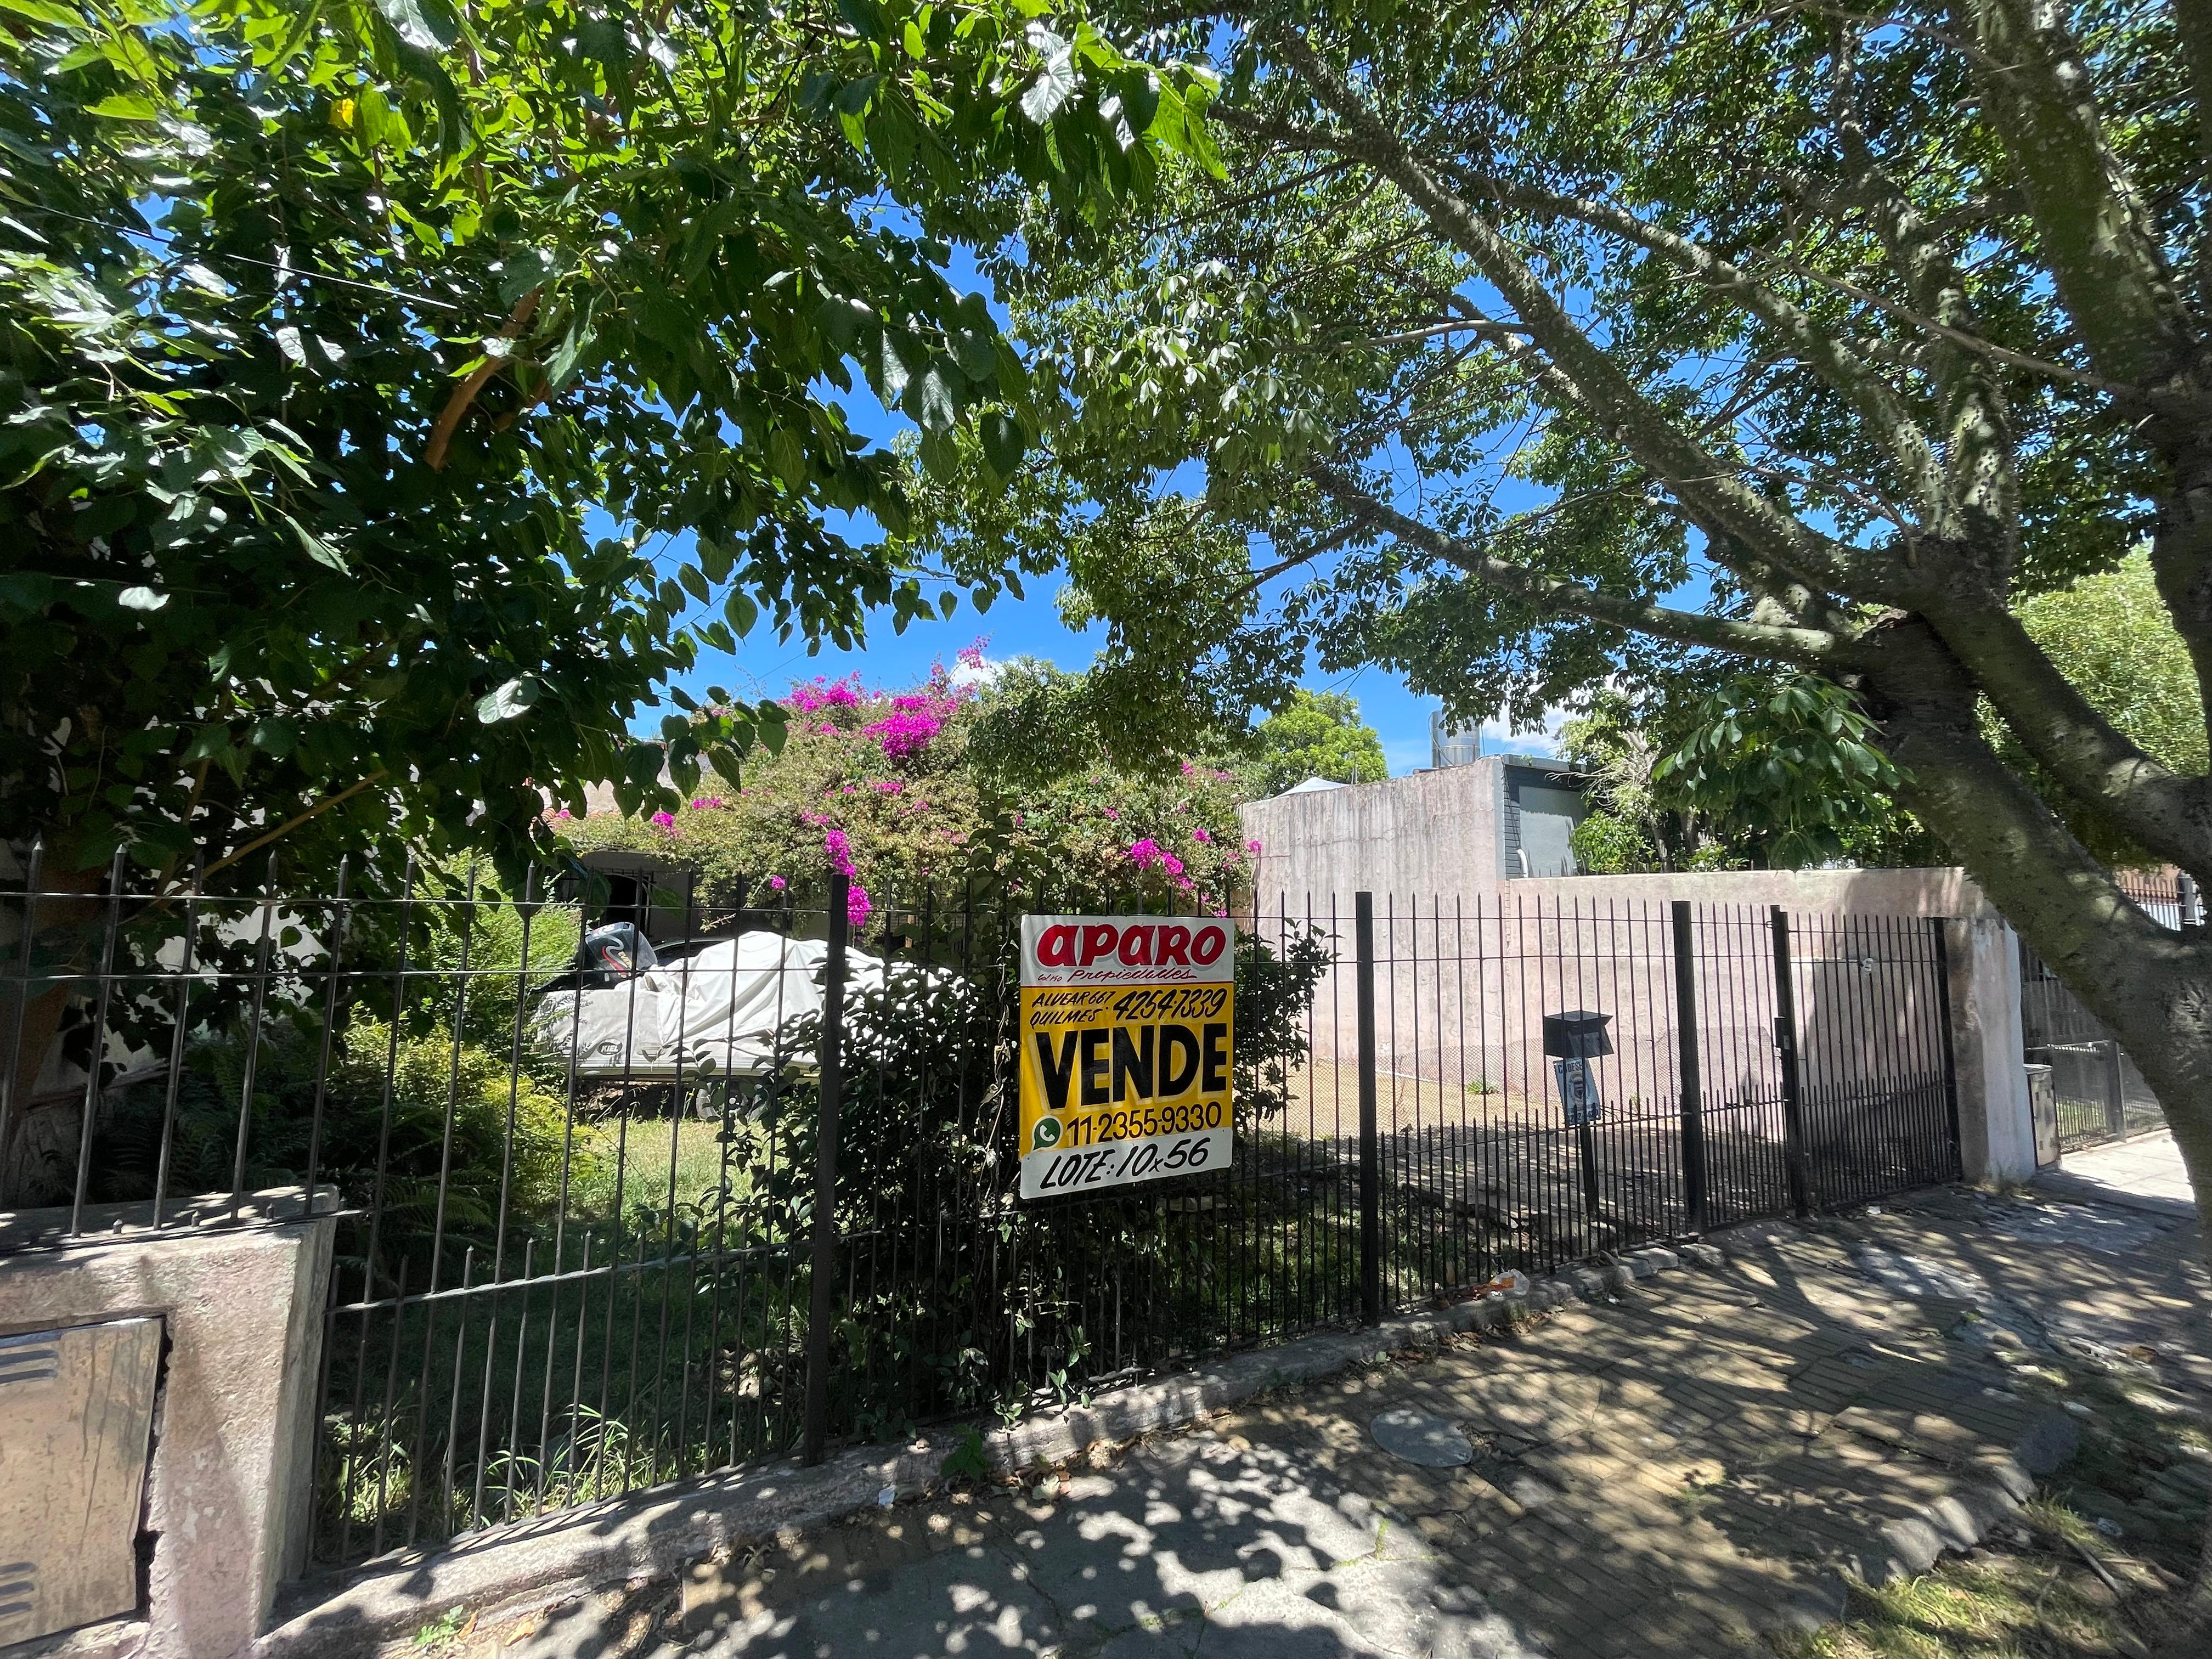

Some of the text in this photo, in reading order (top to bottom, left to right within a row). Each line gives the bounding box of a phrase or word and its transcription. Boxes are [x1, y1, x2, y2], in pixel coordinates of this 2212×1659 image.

[1067, 969, 1198, 983] Propiedades
[1031, 991, 1116, 1008] ALVEAR 667
[1030, 1008, 1103, 1030] QUILMES
[1035, 1023, 1227, 1110] VENDE
